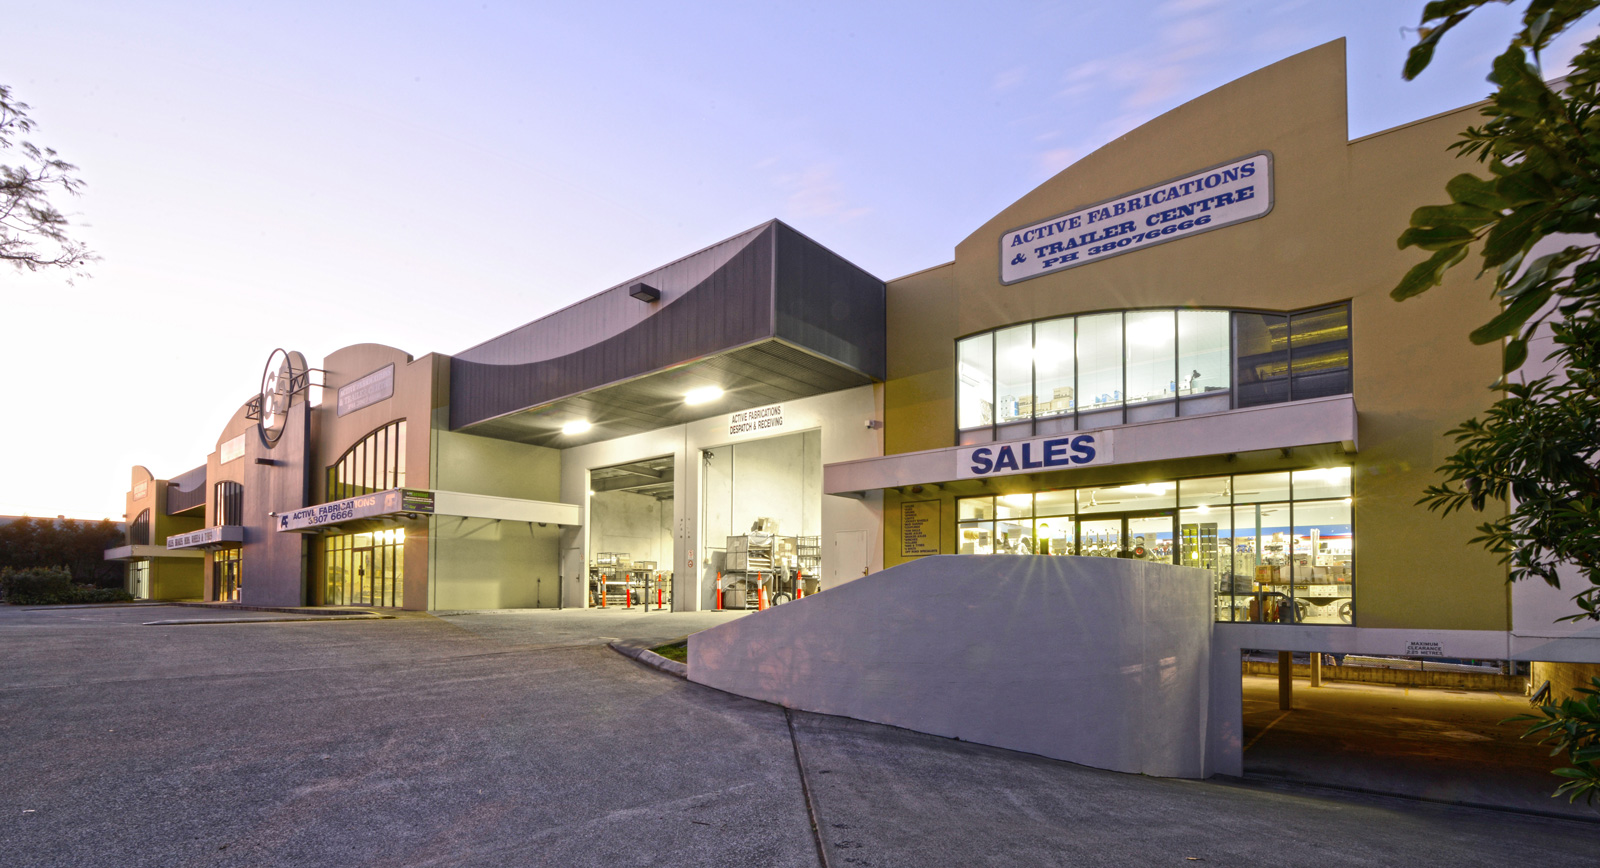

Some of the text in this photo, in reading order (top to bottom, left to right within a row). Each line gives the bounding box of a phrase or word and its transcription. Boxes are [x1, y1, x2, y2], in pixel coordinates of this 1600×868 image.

[1010, 161, 1256, 247] ACTIVE FABRICATIONS
[1010, 185, 1255, 266] & TRAILER CENTRE
[1042, 214, 1213, 269] PH 38076666
[730, 422, 752, 434] DESPATCH
[758, 417, 783, 429] RECEIVING
[732, 406, 781, 424] ACTIVE FABRICATIONS
[970, 434, 1096, 475] SALES
[292, 496, 376, 521] ACTIVE FABRICATIONS
[308, 509, 353, 526] 3807 6666
